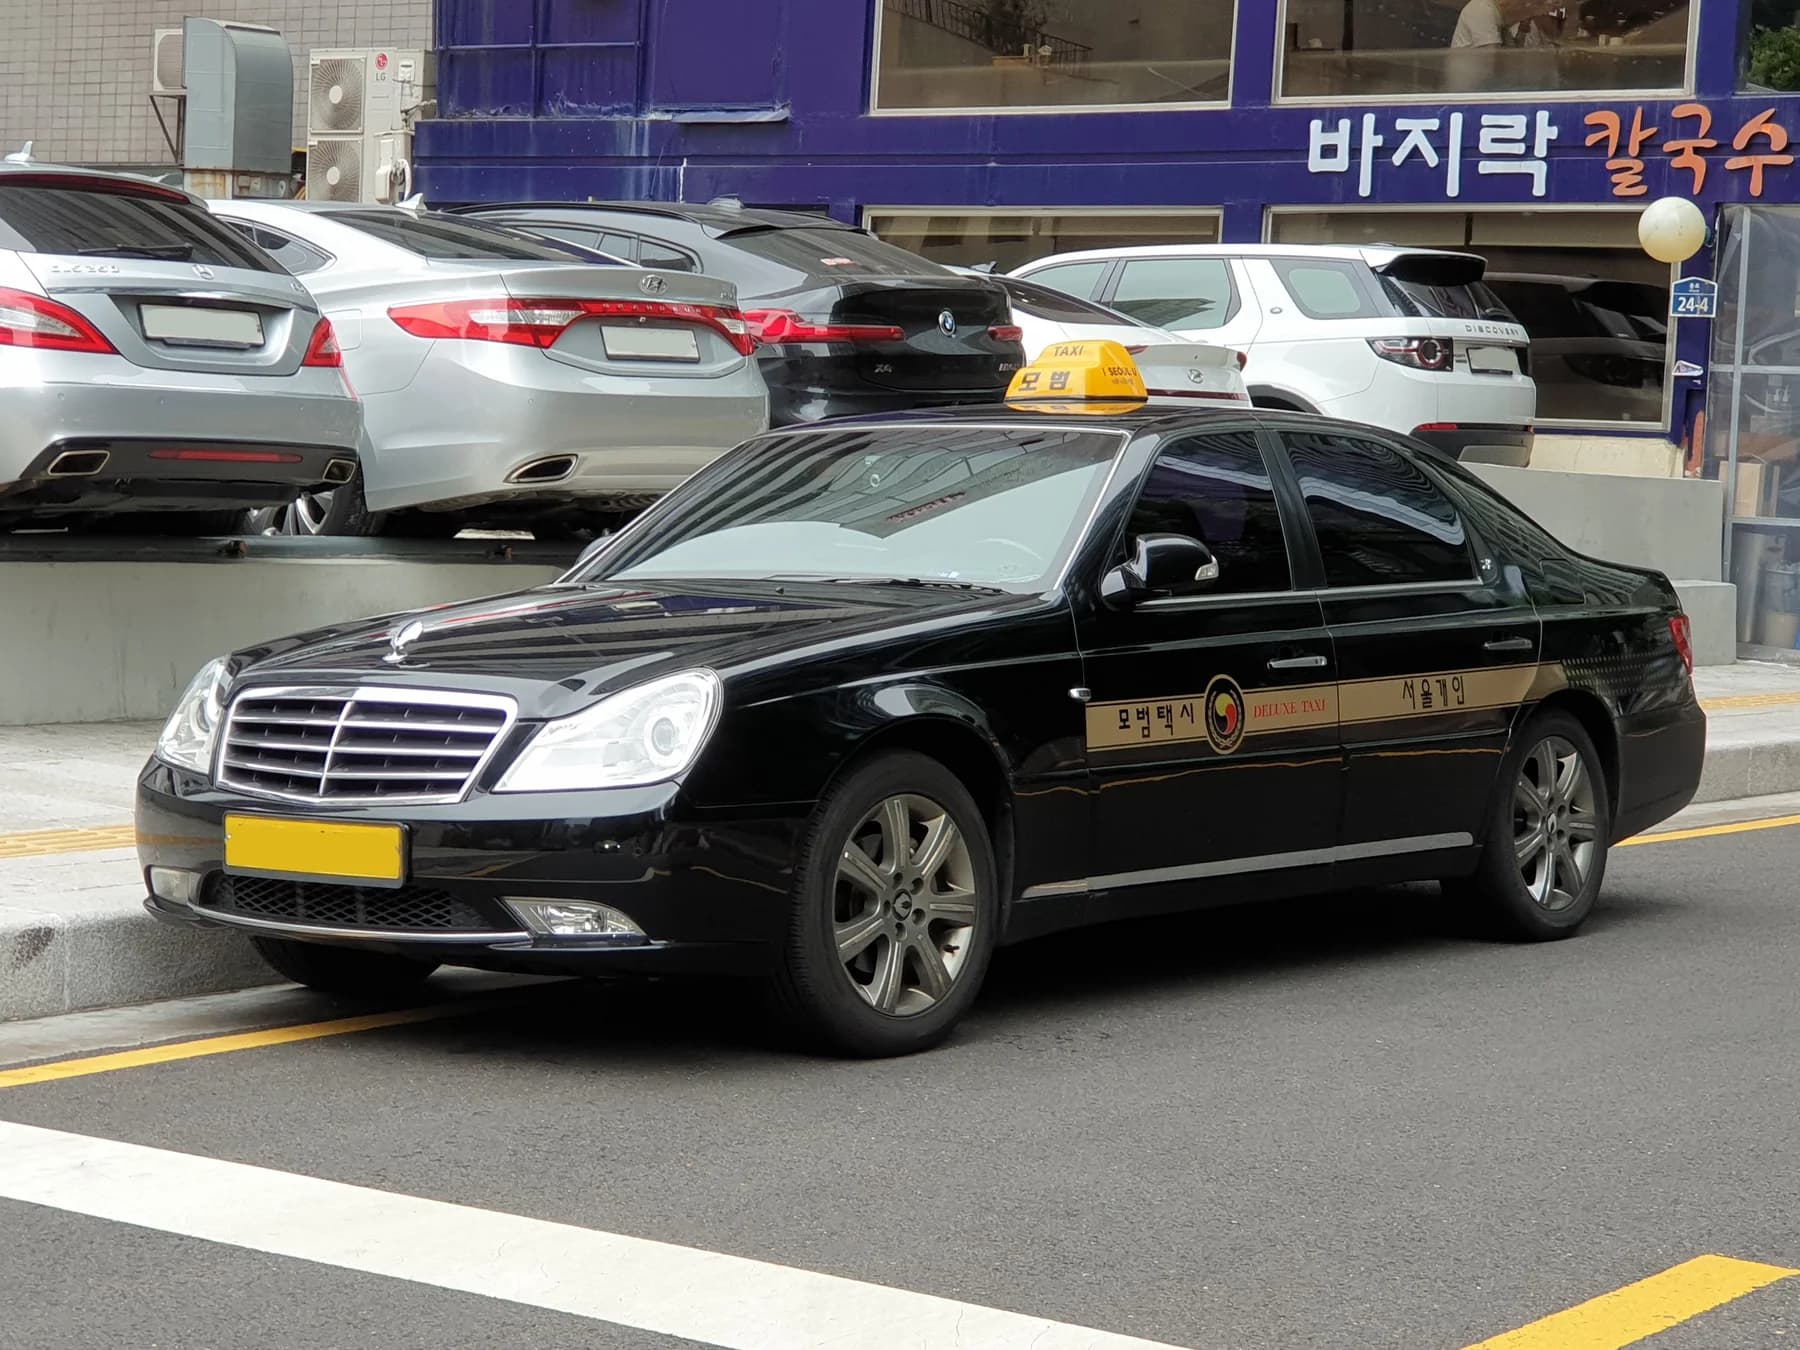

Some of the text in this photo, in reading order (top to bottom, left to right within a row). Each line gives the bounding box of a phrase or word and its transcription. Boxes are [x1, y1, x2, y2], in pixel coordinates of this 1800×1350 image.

[375, 72, 387, 81] LG
[1307, 104, 1795, 198] 바지락 칼국수
[1677, 296, 1709, 313] 24-4
[1464, 324, 1520, 336] DISCOVERY
[1053, 345, 1085, 357] TAXI
[1402, 675, 1465, 710] 서울개인
[1253, 698, 1327, 719] DELUXE TAXI
[1118, 702, 1195, 739] 모범택시
